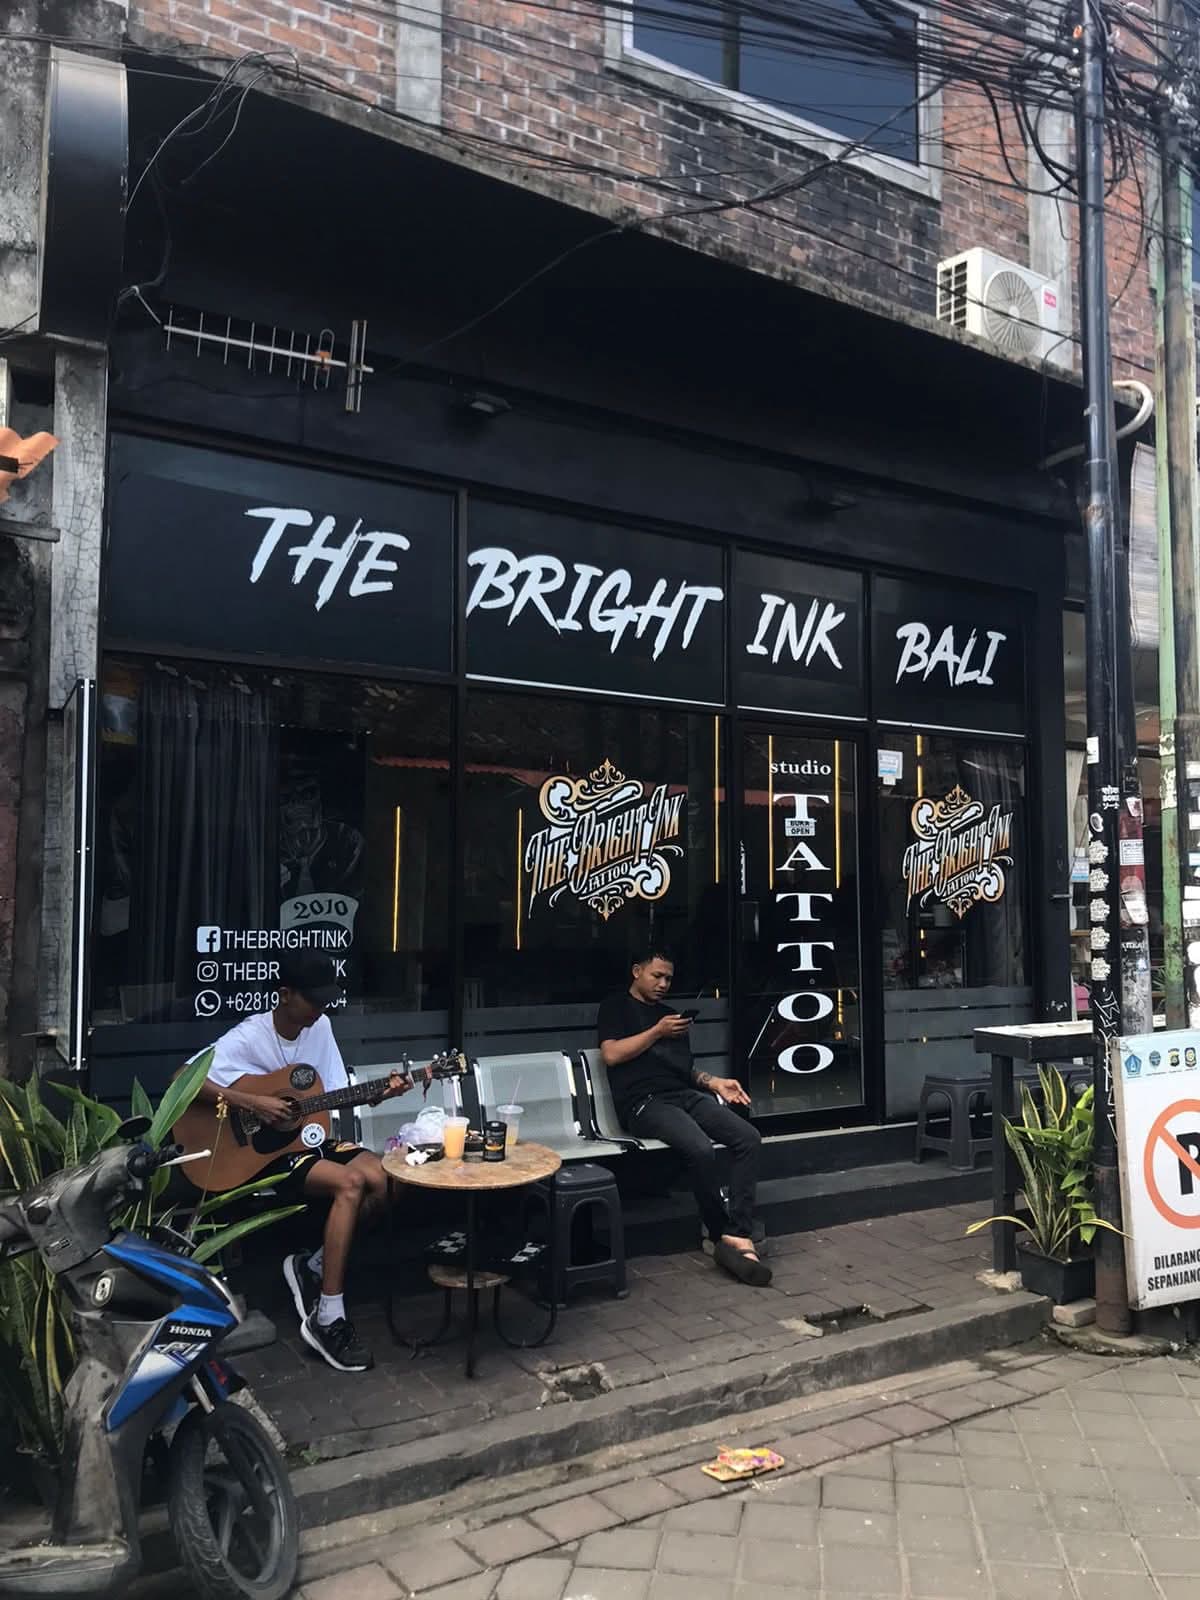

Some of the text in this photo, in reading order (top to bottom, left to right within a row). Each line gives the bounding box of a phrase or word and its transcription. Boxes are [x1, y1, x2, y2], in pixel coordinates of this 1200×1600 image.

[245, 507, 1006, 687] THE BRIGHT INK BALI
[769, 760, 832, 775] studio
[588, 861, 629, 892] TATTOO
[947, 870, 976, 894] TATTOO
[294, 900, 348, 920] 2010
[223, 930, 348, 949] THEBRIGHTINK
[773, 793, 835, 1074] TATTOO
[222, 959, 347, 981] THEBRK
[169, 1325, 212, 1337] HONDA
